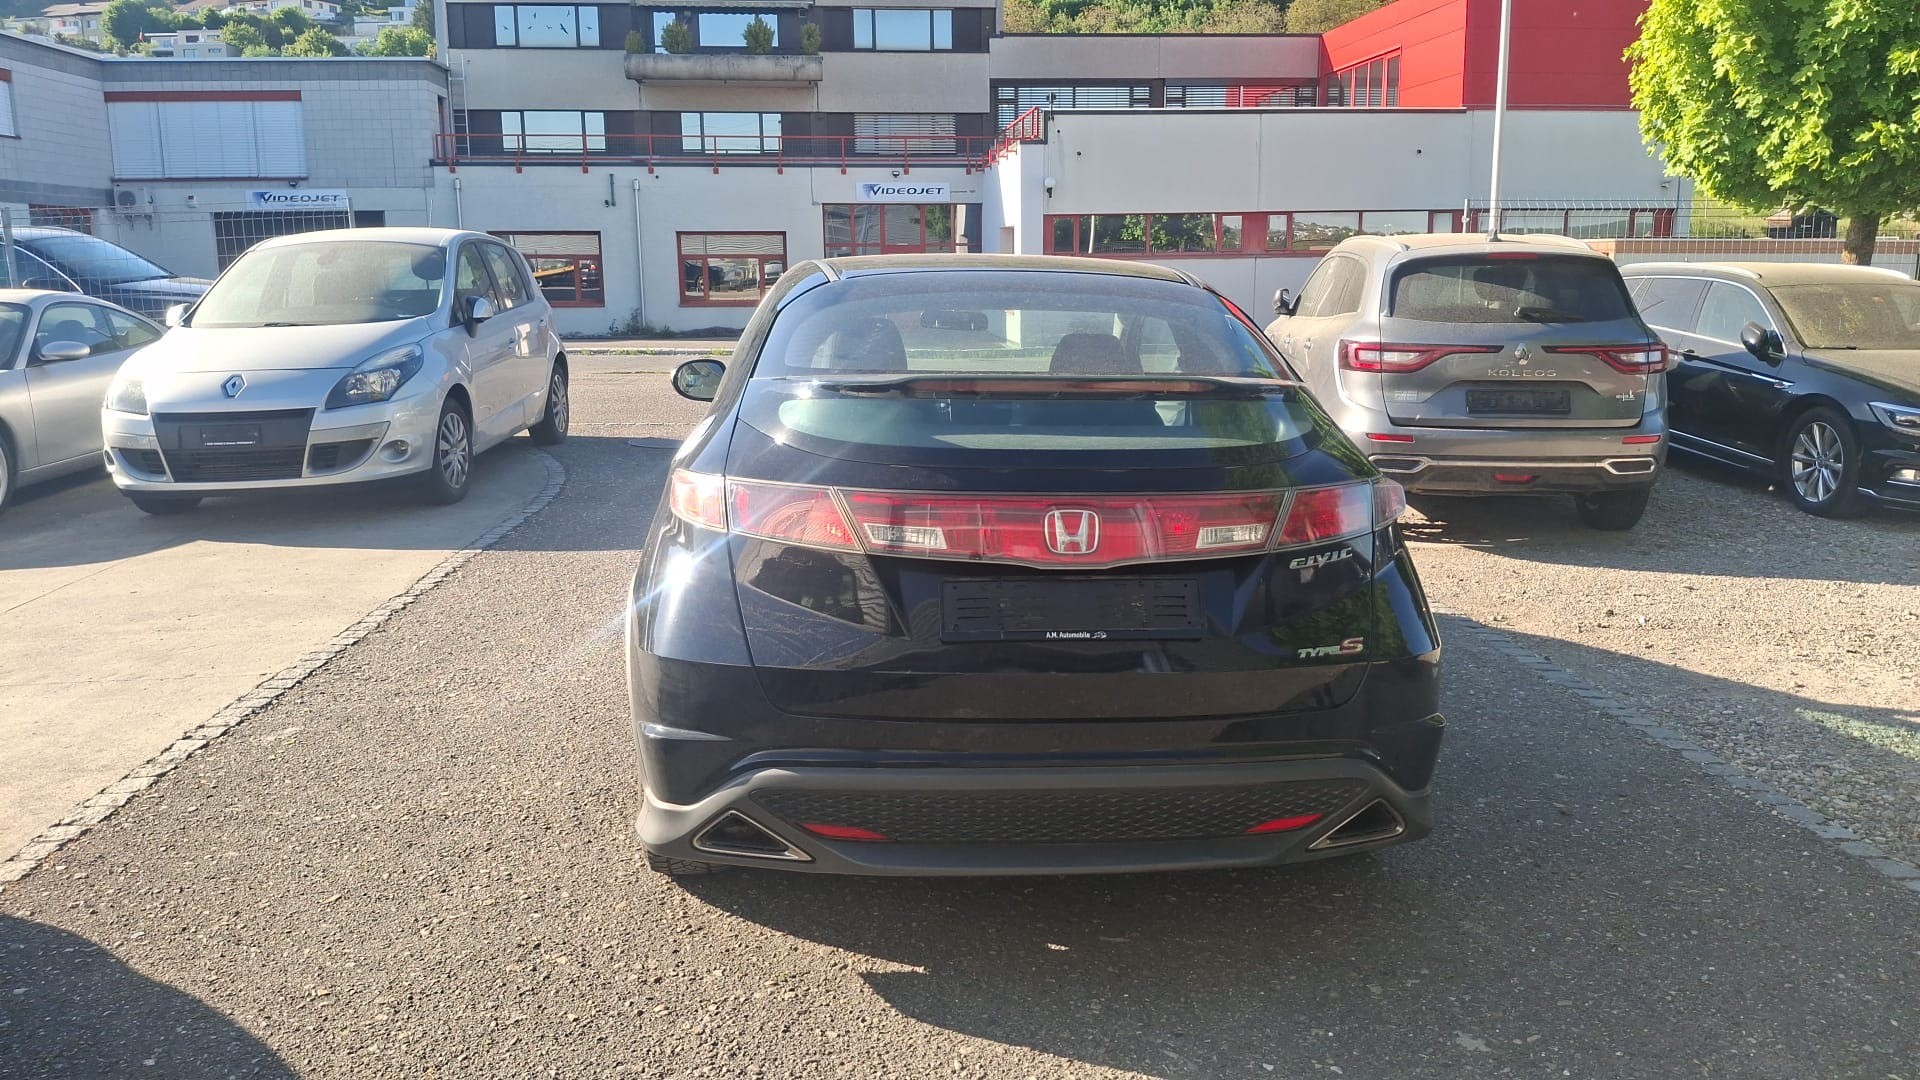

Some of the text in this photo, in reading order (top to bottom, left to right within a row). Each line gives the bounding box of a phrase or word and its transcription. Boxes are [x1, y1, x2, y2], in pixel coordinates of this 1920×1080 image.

[870, 183, 945, 196] VIDEOJET
[260, 190, 341, 202] VIDEOJET
[1487, 368, 1557, 377] KOLEOS
[1289, 547, 1353, 569] CIVIC
[1060, 631, 1091, 639] Automobile
[1298, 636, 1364, 658] TYPE S
